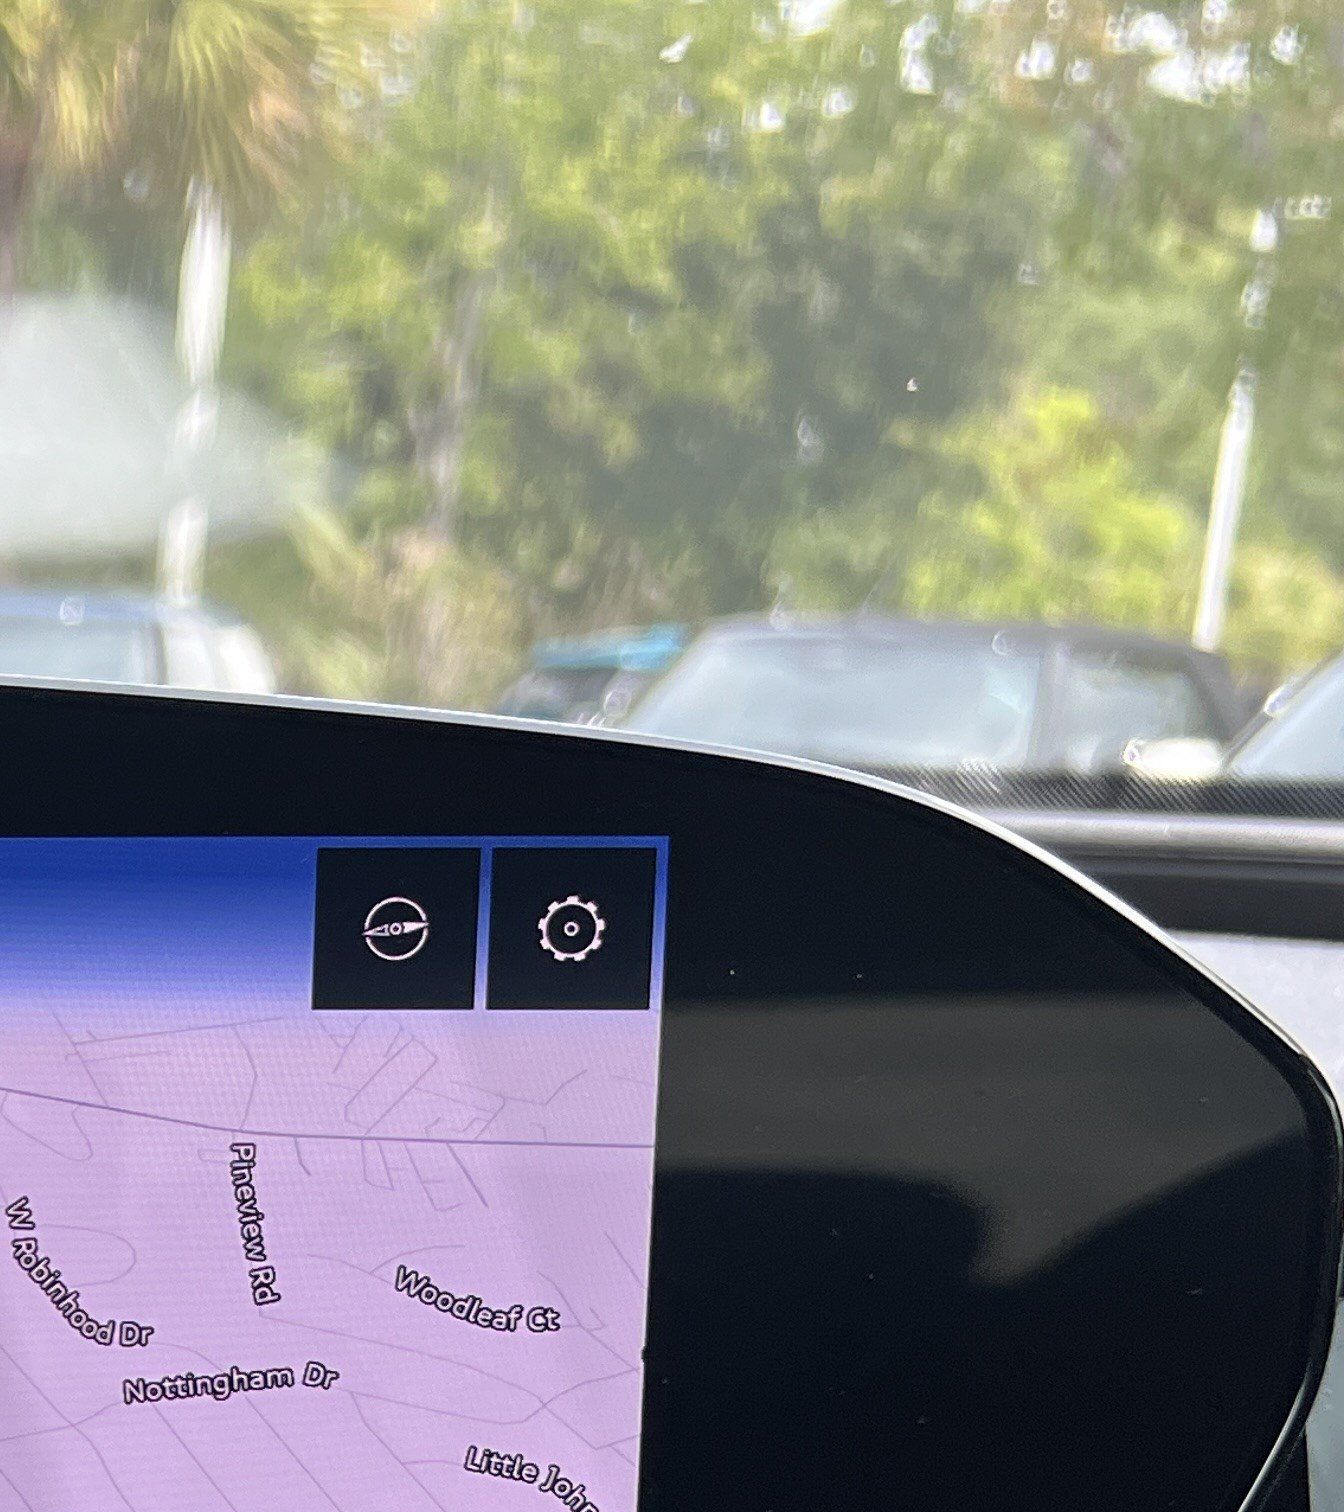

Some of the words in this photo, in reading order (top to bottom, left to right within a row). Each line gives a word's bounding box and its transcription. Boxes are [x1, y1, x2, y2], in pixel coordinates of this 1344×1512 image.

[5, 1196, 35, 1231] W
[230, 1142, 266, 1263] Pineview
[249, 1265, 280, 1306] Rd
[12, 1237, 114, 1346] Robinhood
[395, 1264, 523, 1332] Woodleaf
[526, 1306, 560, 1334] Ct
[118, 1320, 154, 1348] Dr
[123, 1365, 294, 1404] Nottingham
[302, 1361, 339, 1389] Dr
[464, 1445, 540, 1485] Little
